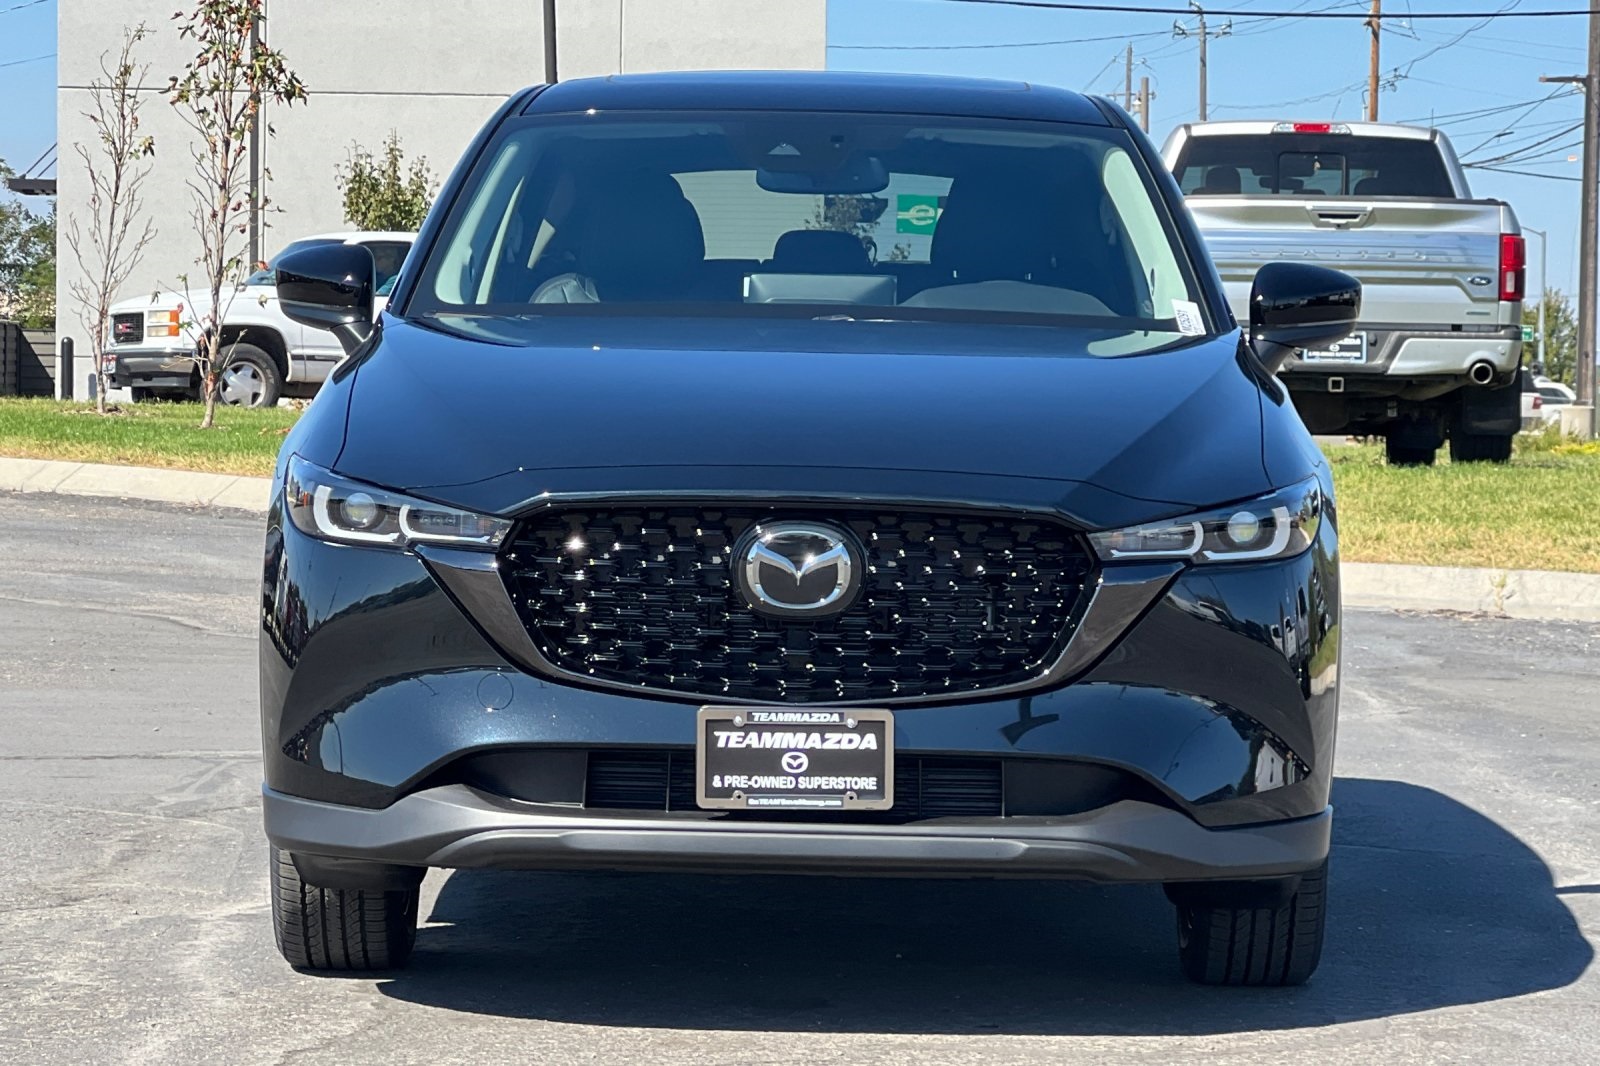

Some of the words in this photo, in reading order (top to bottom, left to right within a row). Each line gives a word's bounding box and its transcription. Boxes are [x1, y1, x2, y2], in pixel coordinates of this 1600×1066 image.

[752, 712, 840, 723] TEAMMAZDA
[713, 731, 878, 750] TEAMMAZDA
[712, 775, 722, 788] &
[724, 775, 796, 789] PRE-OWNED
[798, 776, 878, 790] SUPERSTORE
